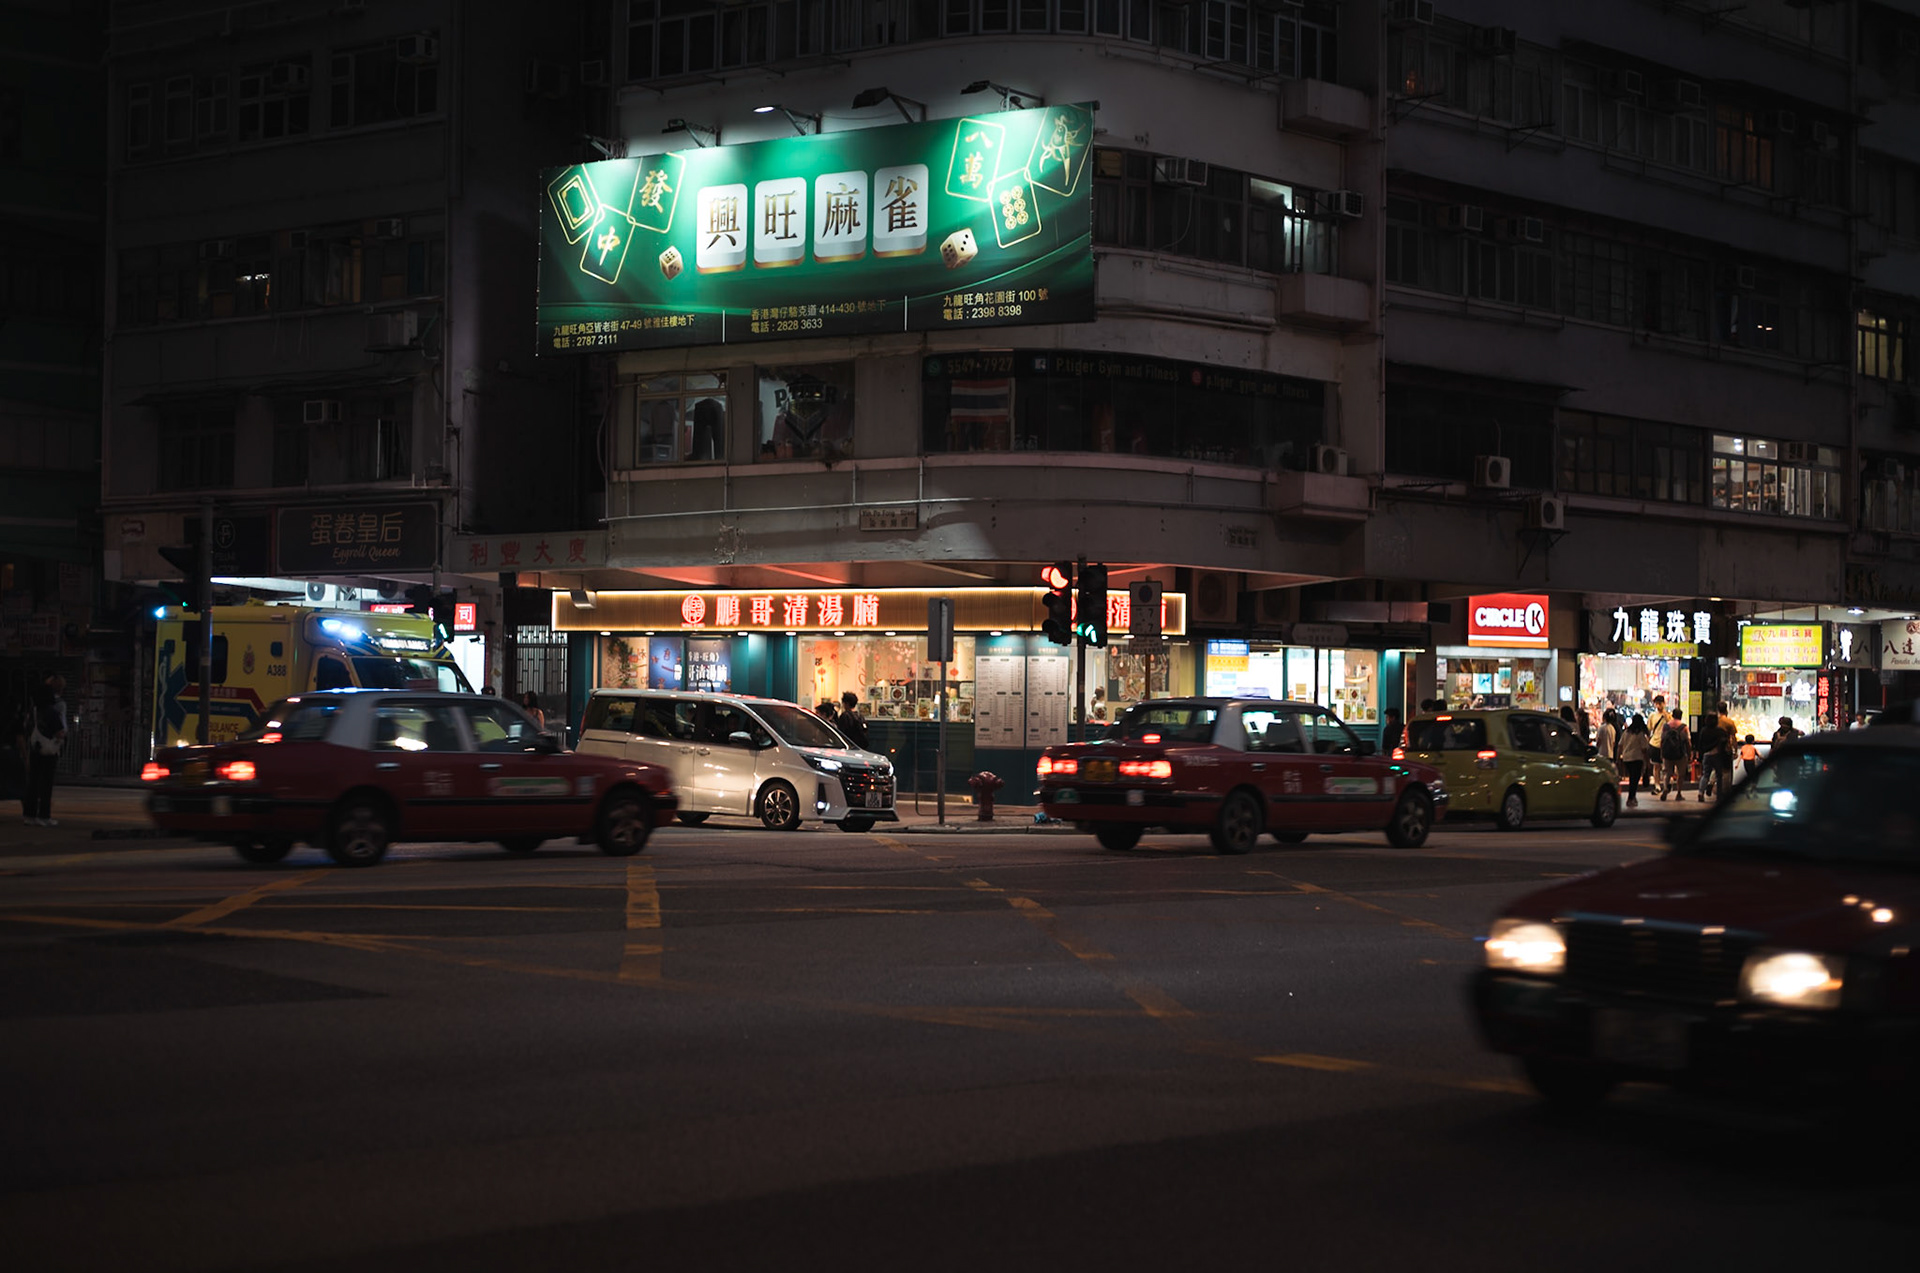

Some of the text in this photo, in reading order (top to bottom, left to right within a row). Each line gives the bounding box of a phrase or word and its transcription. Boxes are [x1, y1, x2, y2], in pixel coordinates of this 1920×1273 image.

[638, 168, 674, 214] 發
[706, 175, 919, 250] 興旺麻雀
[597, 226, 621, 266] 中
[943, 288, 1049, 307] 九龍旺角花園街 100 號
[751, 299, 887, 321] 香港灣仔駱克道 414-430 號地下
[971, 306, 995, 319] 2398
[998, 305, 1022, 317] 8398
[553, 319, 619, 337] 九龍旺角亞皆老街
[620, 319, 643, 331] 47-49
[777, 320, 799, 332] 2828
[801, 318, 823, 330] 3633
[576, 336, 596, 347] 2787
[598, 334, 618, 345] 2111
[1098, 359, 1121, 379] Gym
[1124, 364, 1142, 377] and
[310, 511, 405, 546] 蛋卷皇后
[332, 544, 401, 566] Eggroll Queen
[714, 594, 880, 627] 鵬哥清湯腩
[1474, 607, 1525, 628] CIRCLE
[1612, 606, 1711, 645] 九龍珠寶
[266, 664, 287, 677] A388
